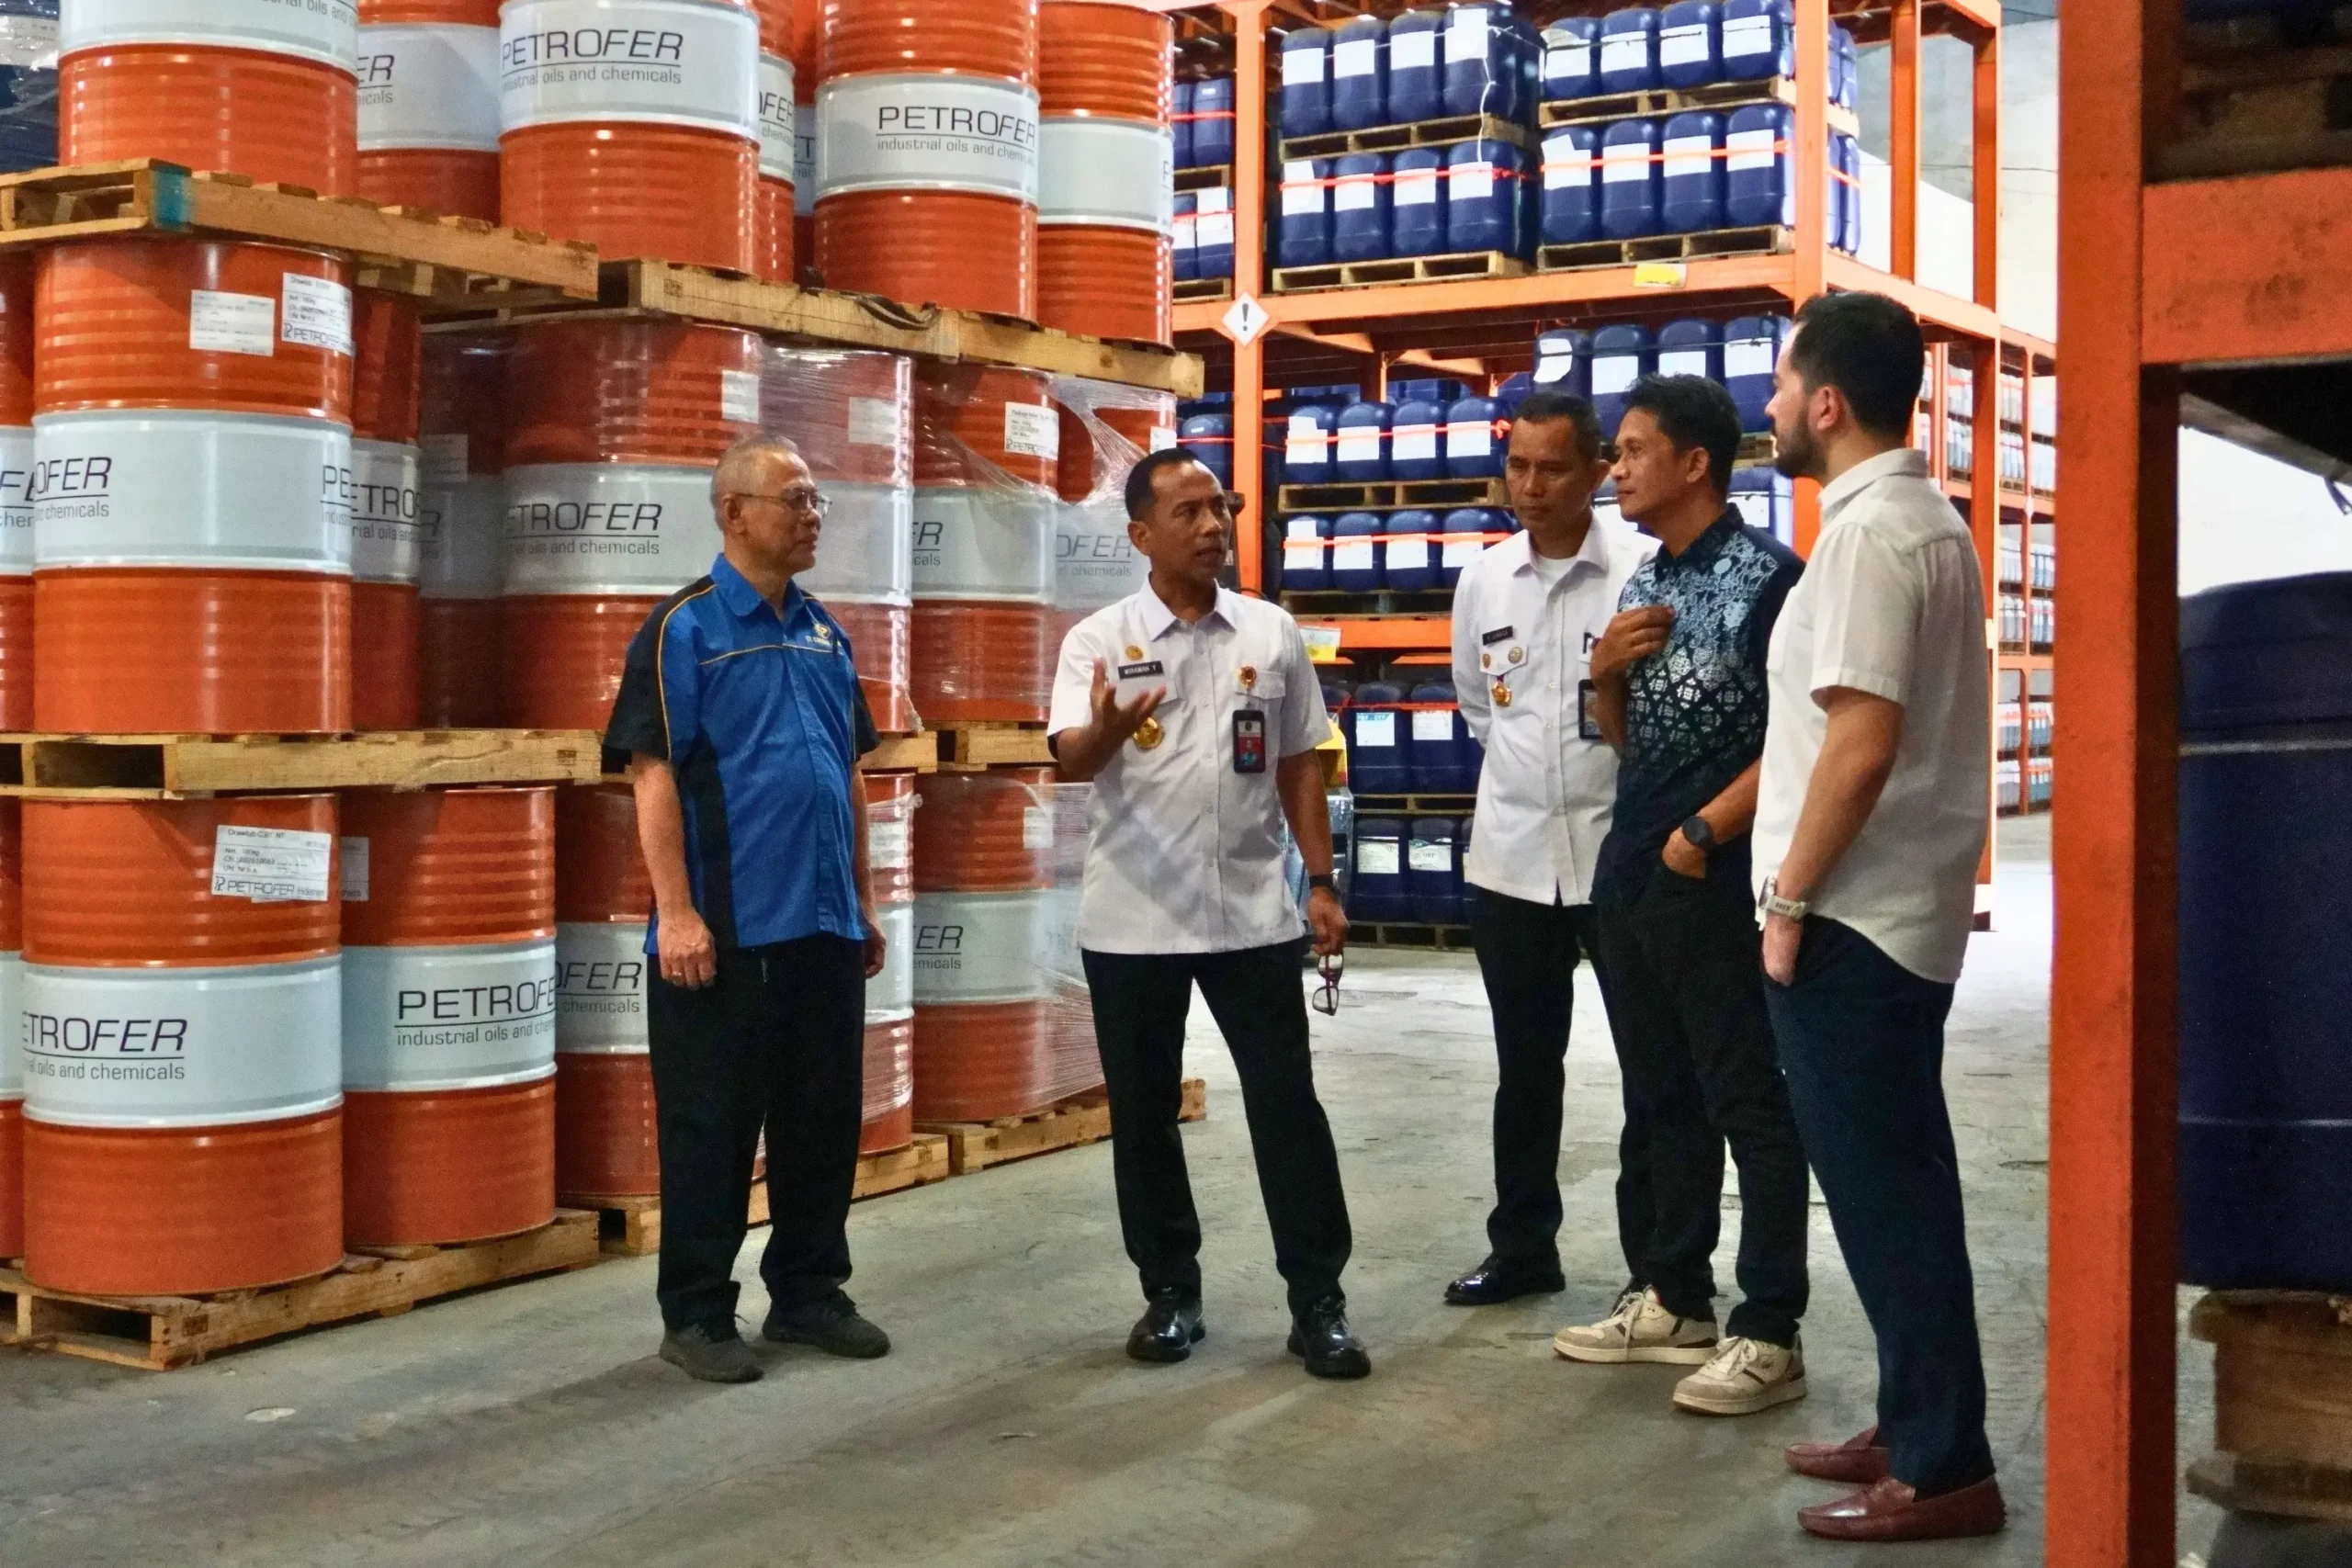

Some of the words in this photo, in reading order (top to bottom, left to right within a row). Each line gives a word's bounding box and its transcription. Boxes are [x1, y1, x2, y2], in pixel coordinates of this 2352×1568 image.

[502, 28, 684, 70] PETROFER
[357, 54, 395, 83] ER
[542, 68, 565, 85] oils
[569, 66, 596, 81] and
[601, 66, 682, 85] chemicals
[878, 106, 1036, 148] PETROFER
[877, 138, 942, 152] industrial
[946, 139, 968, 152] oils
[973, 141, 994, 156] and
[46, 500, 110, 521] chemicals
[580, 539, 660, 555] chemicals
[913, 552, 942, 566] cals
[1071, 564, 1132, 577] chemicals
[227, 880, 296, 896] PETROFER
[913, 926, 964, 950] ER
[398, 976, 556, 1021] PETROFE
[562, 997, 640, 1014] chemicals
[22, 1010, 188, 1053] TROFER
[397, 1026, 479, 1046] industrial
[484, 1026, 508, 1043] oils
[512, 1020, 533, 1039] and
[38, 1059, 56, 1077] oils
[59, 1062, 85, 1079] and
[90, 1062, 186, 1080] chemicals
